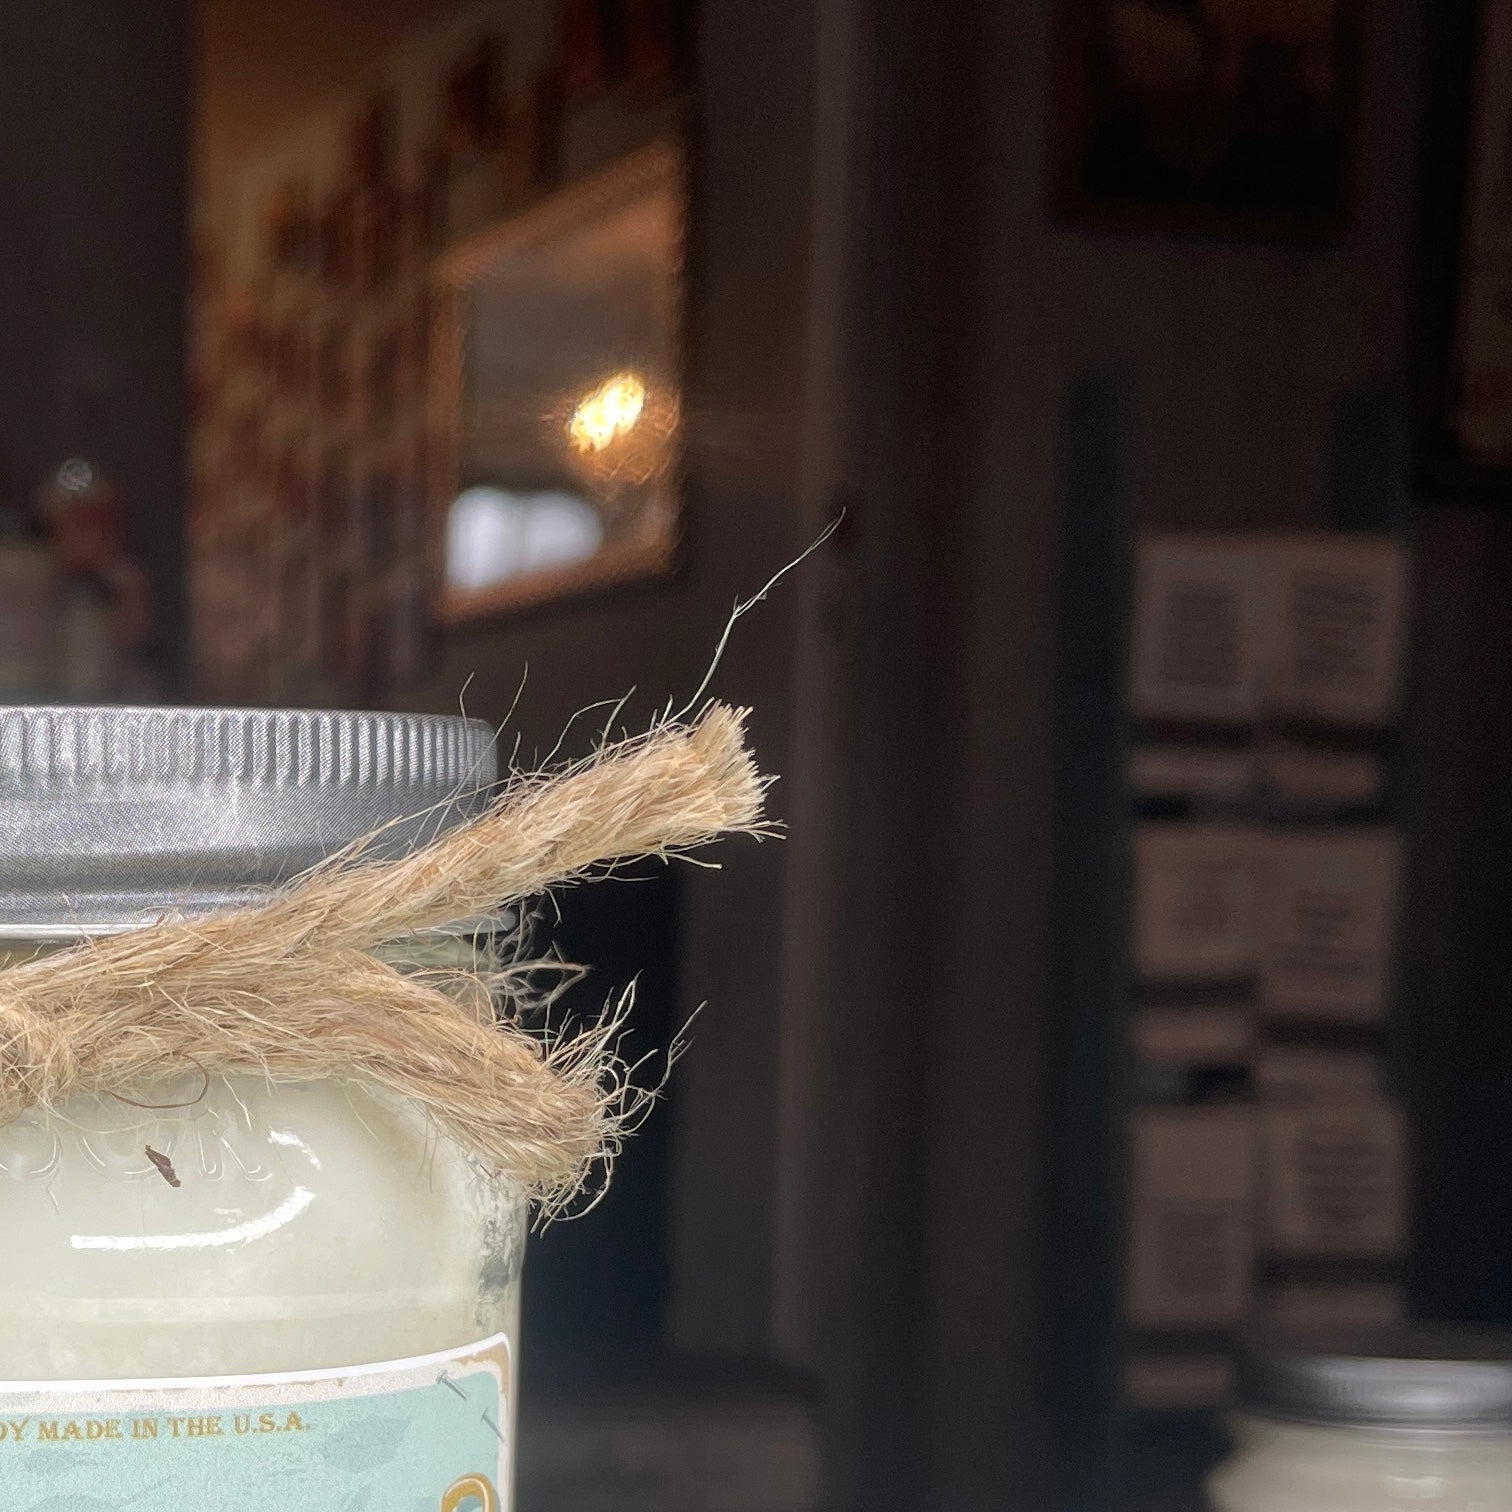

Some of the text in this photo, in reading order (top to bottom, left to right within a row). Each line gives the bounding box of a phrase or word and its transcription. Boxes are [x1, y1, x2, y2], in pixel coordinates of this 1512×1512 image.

[37, 1418, 124, 1442] MADE
[130, 1416, 160, 1440] IN
[166, 1414, 226, 1438] THE
[233, 1410, 311, 1437] U.S.A.
